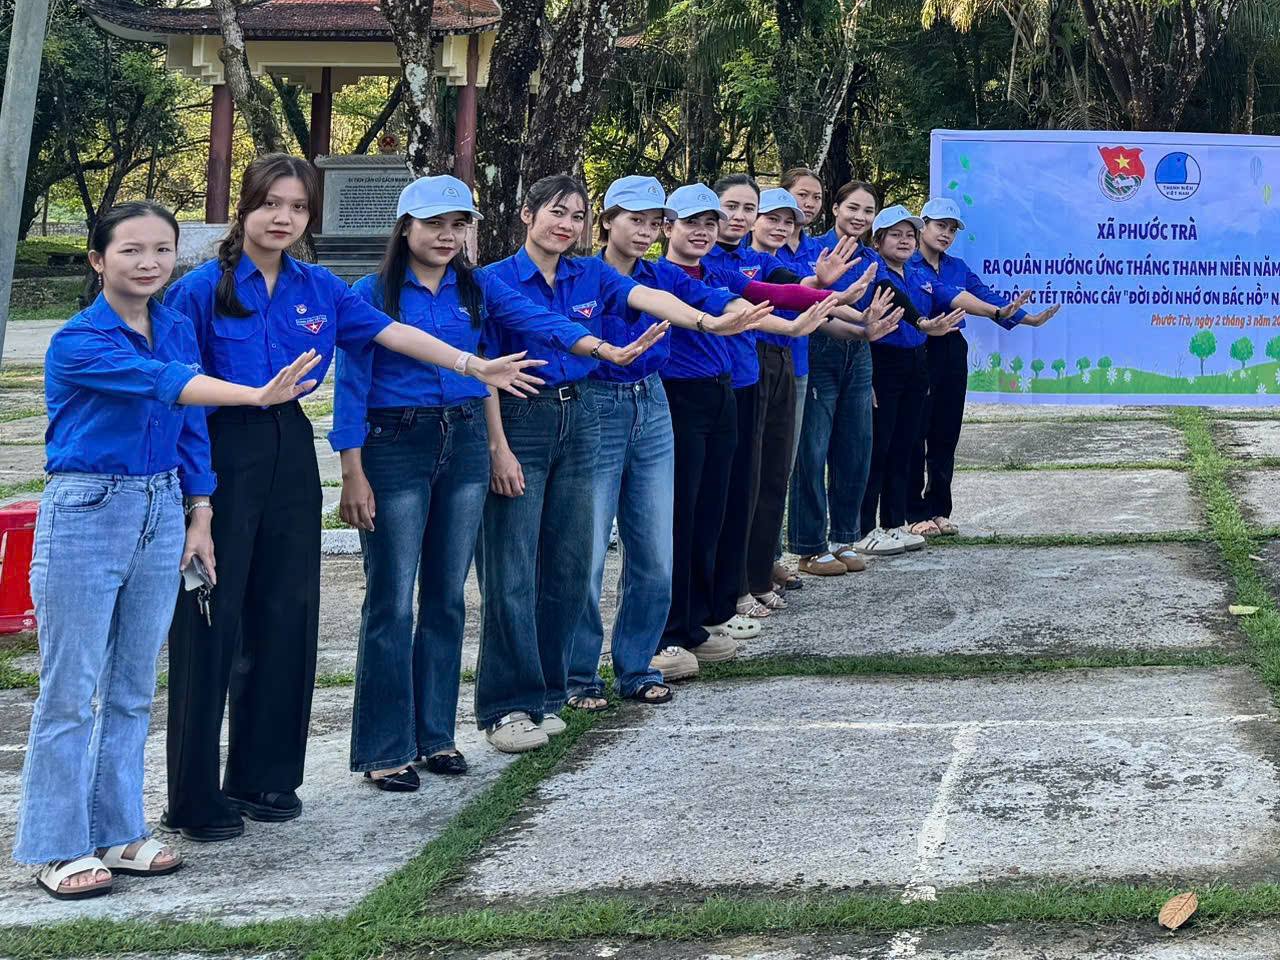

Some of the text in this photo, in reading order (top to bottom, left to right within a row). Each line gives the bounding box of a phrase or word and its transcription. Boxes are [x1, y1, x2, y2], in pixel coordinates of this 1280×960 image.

[1097, 216, 1198, 241] XÃ PHƯỚC TRÀ
[983, 259, 1001, 275] RA
[1003, 253, 1042, 277] QUÂN
[1045, 253, 1093, 276] HƯỞNG
[1096, 252, 1124, 276] ỨNG
[1126, 253, 1170, 276] THÁNG
[1172, 260, 1217, 277] THANH
[1220, 255, 1251, 277] NIÊN
[1039, 280, 1058, 304] TẾT
[1060, 281, 1099, 305] TRỒNG
[1101, 285, 1121, 304] CÂY
[1152, 285, 1173, 305] ĐỜI
[1175, 285, 1202, 305] NHỚ
[1203, 290, 1220, 305] ƠN
[1223, 284, 1245, 306] BÁC
[1151, 313, 1177, 326] Phước
[1194, 314, 1214, 329] ngày
[1215, 314, 1221, 326] 2
[1221, 314, 1246, 329] tháng
[1246, 315, 1252, 326] 3
[1253, 315, 1271, 326] năm
